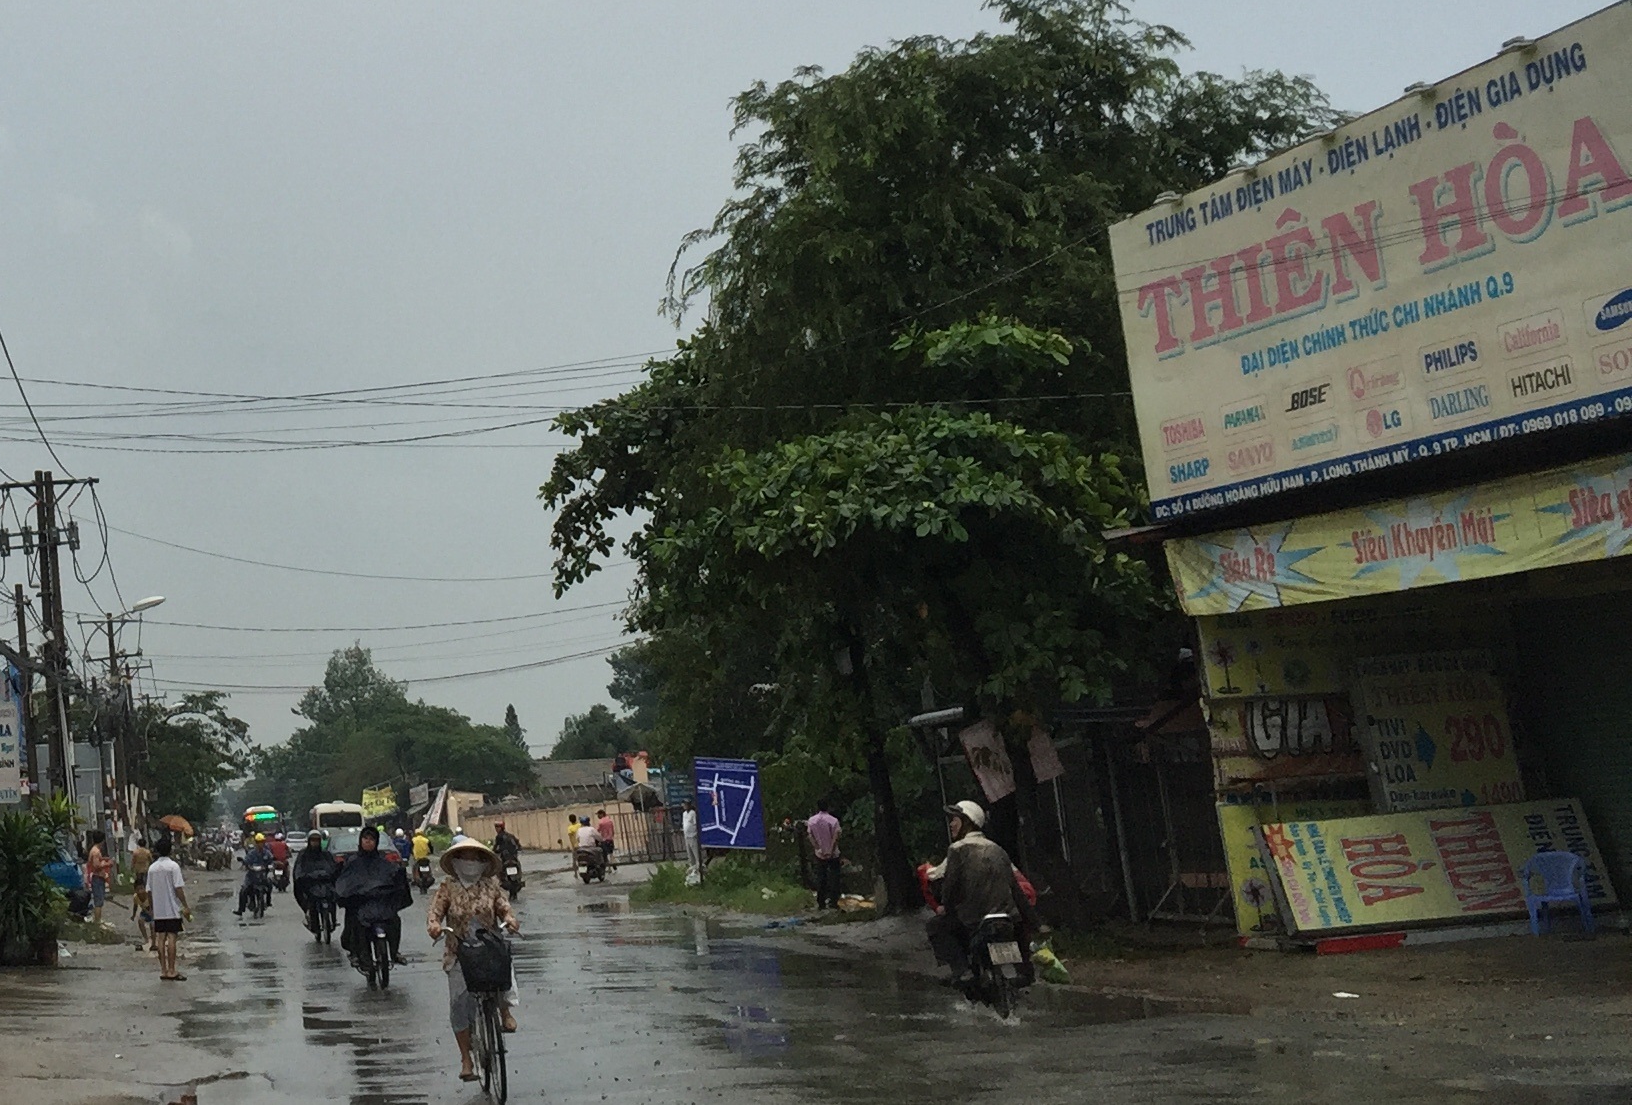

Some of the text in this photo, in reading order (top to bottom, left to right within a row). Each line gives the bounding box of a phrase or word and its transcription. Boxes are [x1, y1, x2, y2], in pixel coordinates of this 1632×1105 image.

[1146, 42, 1587, 246] TRUNG TÂM ĐIỆN MÁY ĐIỆN LẠNH ĐIỆN GIA DỤNG
[1137, 115, 1632, 356] THIÊN HÒA
[1241, 271, 1515, 378] ĐẠI DIỆN CHÍNH THỨC CHI NHÁNH Q.9
[1424, 341, 1478, 374] PHILIPS
[1598, 347, 1632, 375] SO
[1511, 363, 1572, 398] HITACHI
[1285, 383, 1331, 413] BOSE
[1430, 384, 1490, 420] DARLING
[1163, 417, 1206, 447] TOSHIBA
[1382, 409, 1402, 430] LG
[1228, 442, 1274, 471] SANYO
[1281, 473, 1304, 492] NAM
[1323, 463, 1351, 480] LONG
[1463, 428, 1492, 447] HCM
[1521, 415, 1553, 433] 0969
[1554, 408, 1578, 426] 018
[1579, 402, 1605, 421] 089
[1169, 456, 1210, 485] SHARP
[1569, 486, 1615, 528] Siêu
[1352, 527, 1389, 564] Siêu
[1391, 510, 1457, 562] Khuyến
[1374, 717, 1408, 737] TIVI
[1378, 740, 1413, 761] DVD
[1384, 762, 1418, 784] LOA
[1340, 832, 1437, 907] HÒA
